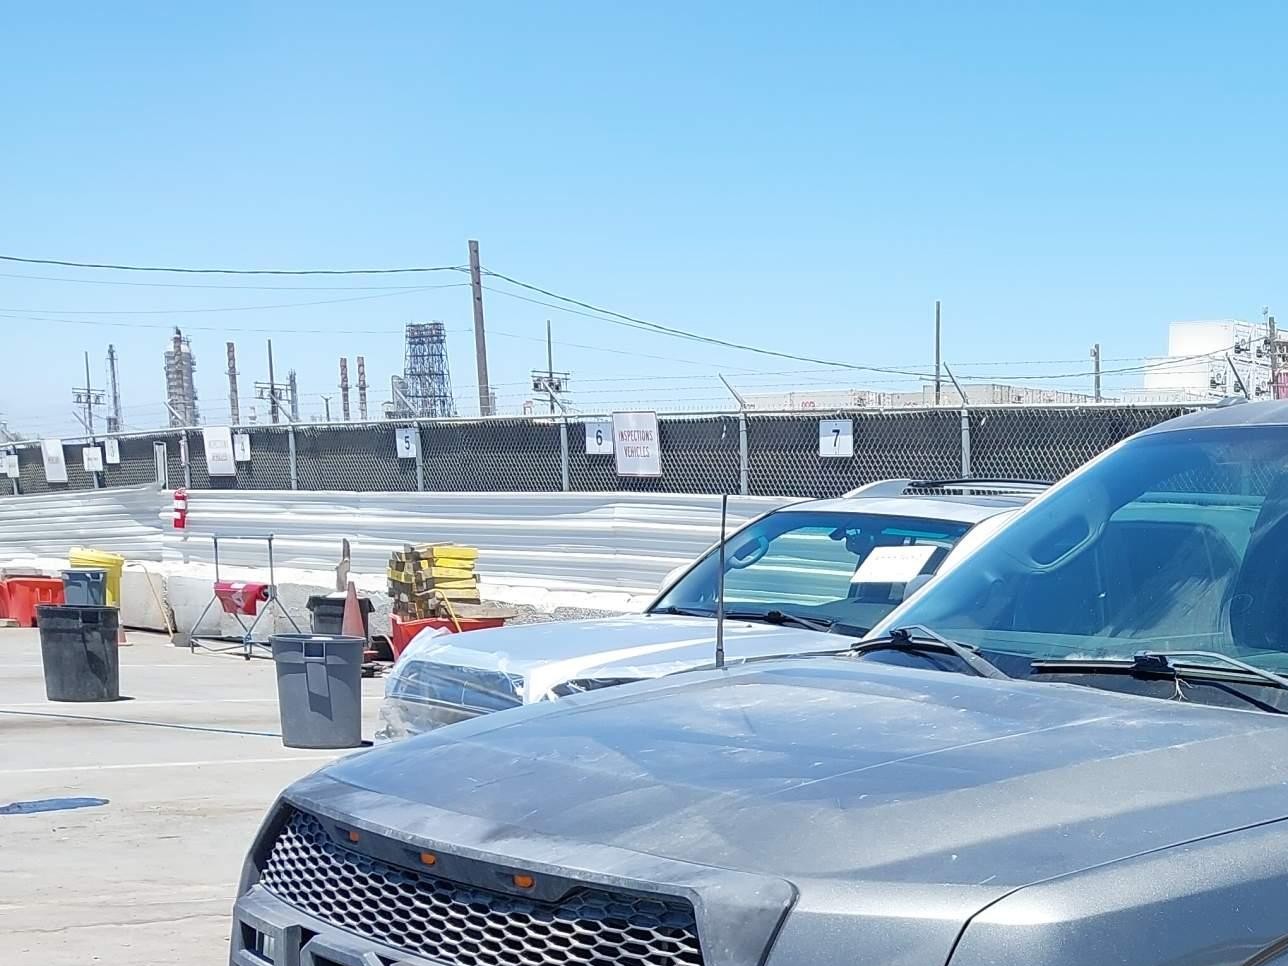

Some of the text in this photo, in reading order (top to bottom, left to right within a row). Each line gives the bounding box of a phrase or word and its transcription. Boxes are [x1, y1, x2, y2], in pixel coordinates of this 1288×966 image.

[404, 435, 411, 450] 5
[596, 430, 603, 446] 6
[619, 430, 653, 441] INSPECTIONS
[832, 429, 840, 447] 7
[624, 446, 650, 457] VEHICLES
